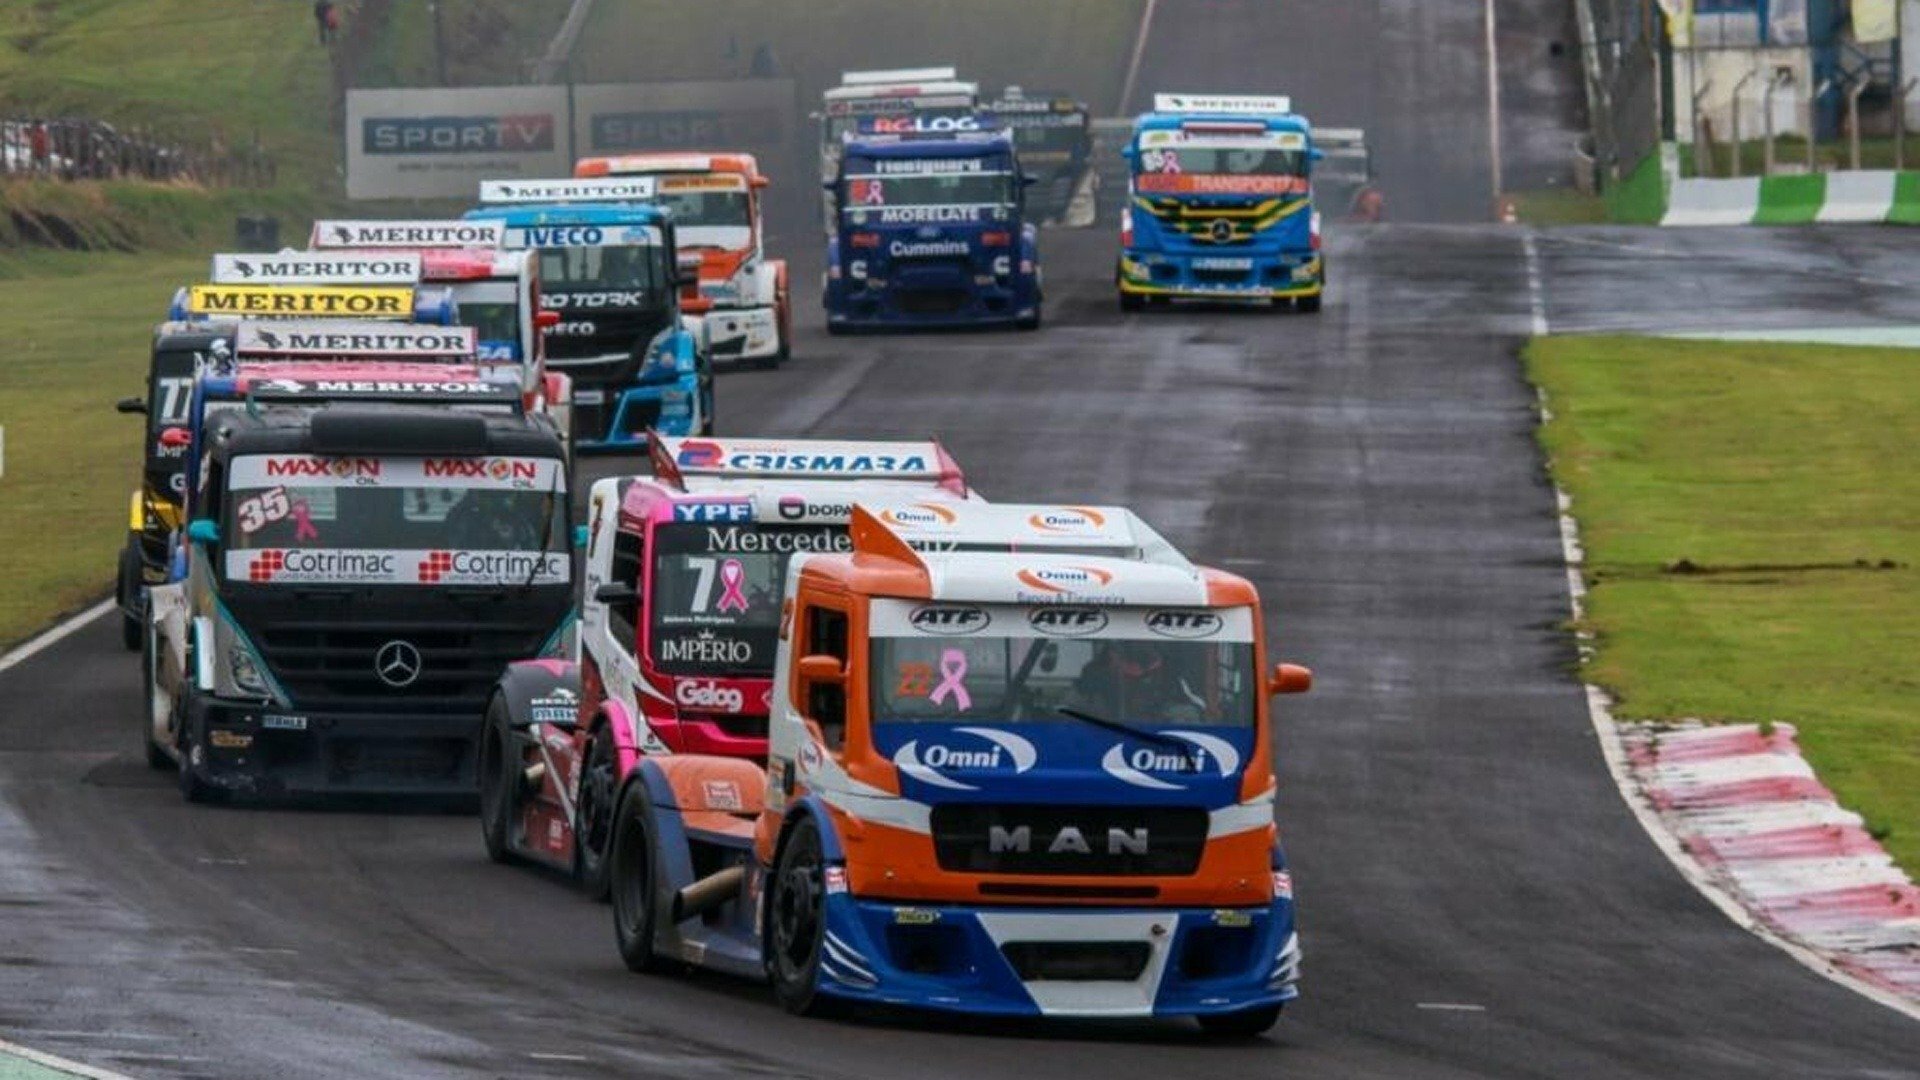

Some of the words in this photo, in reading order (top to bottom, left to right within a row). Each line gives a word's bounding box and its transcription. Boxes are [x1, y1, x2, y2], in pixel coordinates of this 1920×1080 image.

[374, 122, 541, 148] SPORTV
[519, 185, 646, 197] MERITOR
[359, 227, 495, 242] MERITOR
[524, 228, 603, 245] IVECO
[890, 240, 969, 256] Cummins
[261, 261, 413, 277] MERITOR
[202, 291, 401, 312] MERITOR
[290, 332, 465, 351] MERITOR
[317, 381, 492, 393] MERITOR
[267, 458, 380, 478] MAXON
[424, 459, 536, 479] MAXON
[731, 455, 926, 471] CRISMARA
[239, 486, 290, 533] 35
[676, 504, 750, 521] YPF
[896, 511, 936, 523] Omni
[1045, 514, 1086, 526] Omni
[283, 552, 394, 573] Cotrimac
[452, 553, 559, 575] Cotrimac
[689, 558, 716, 613] 7
[912, 607, 982, 626] ATF
[1030, 607, 1101, 625] ATF
[1147, 609, 1216, 627] ATF
[899, 665, 932, 696] 22
[677, 681, 743, 712] Gelog
[924, 744, 1000, 768] Omni
[989, 824, 1149, 854] MAN
